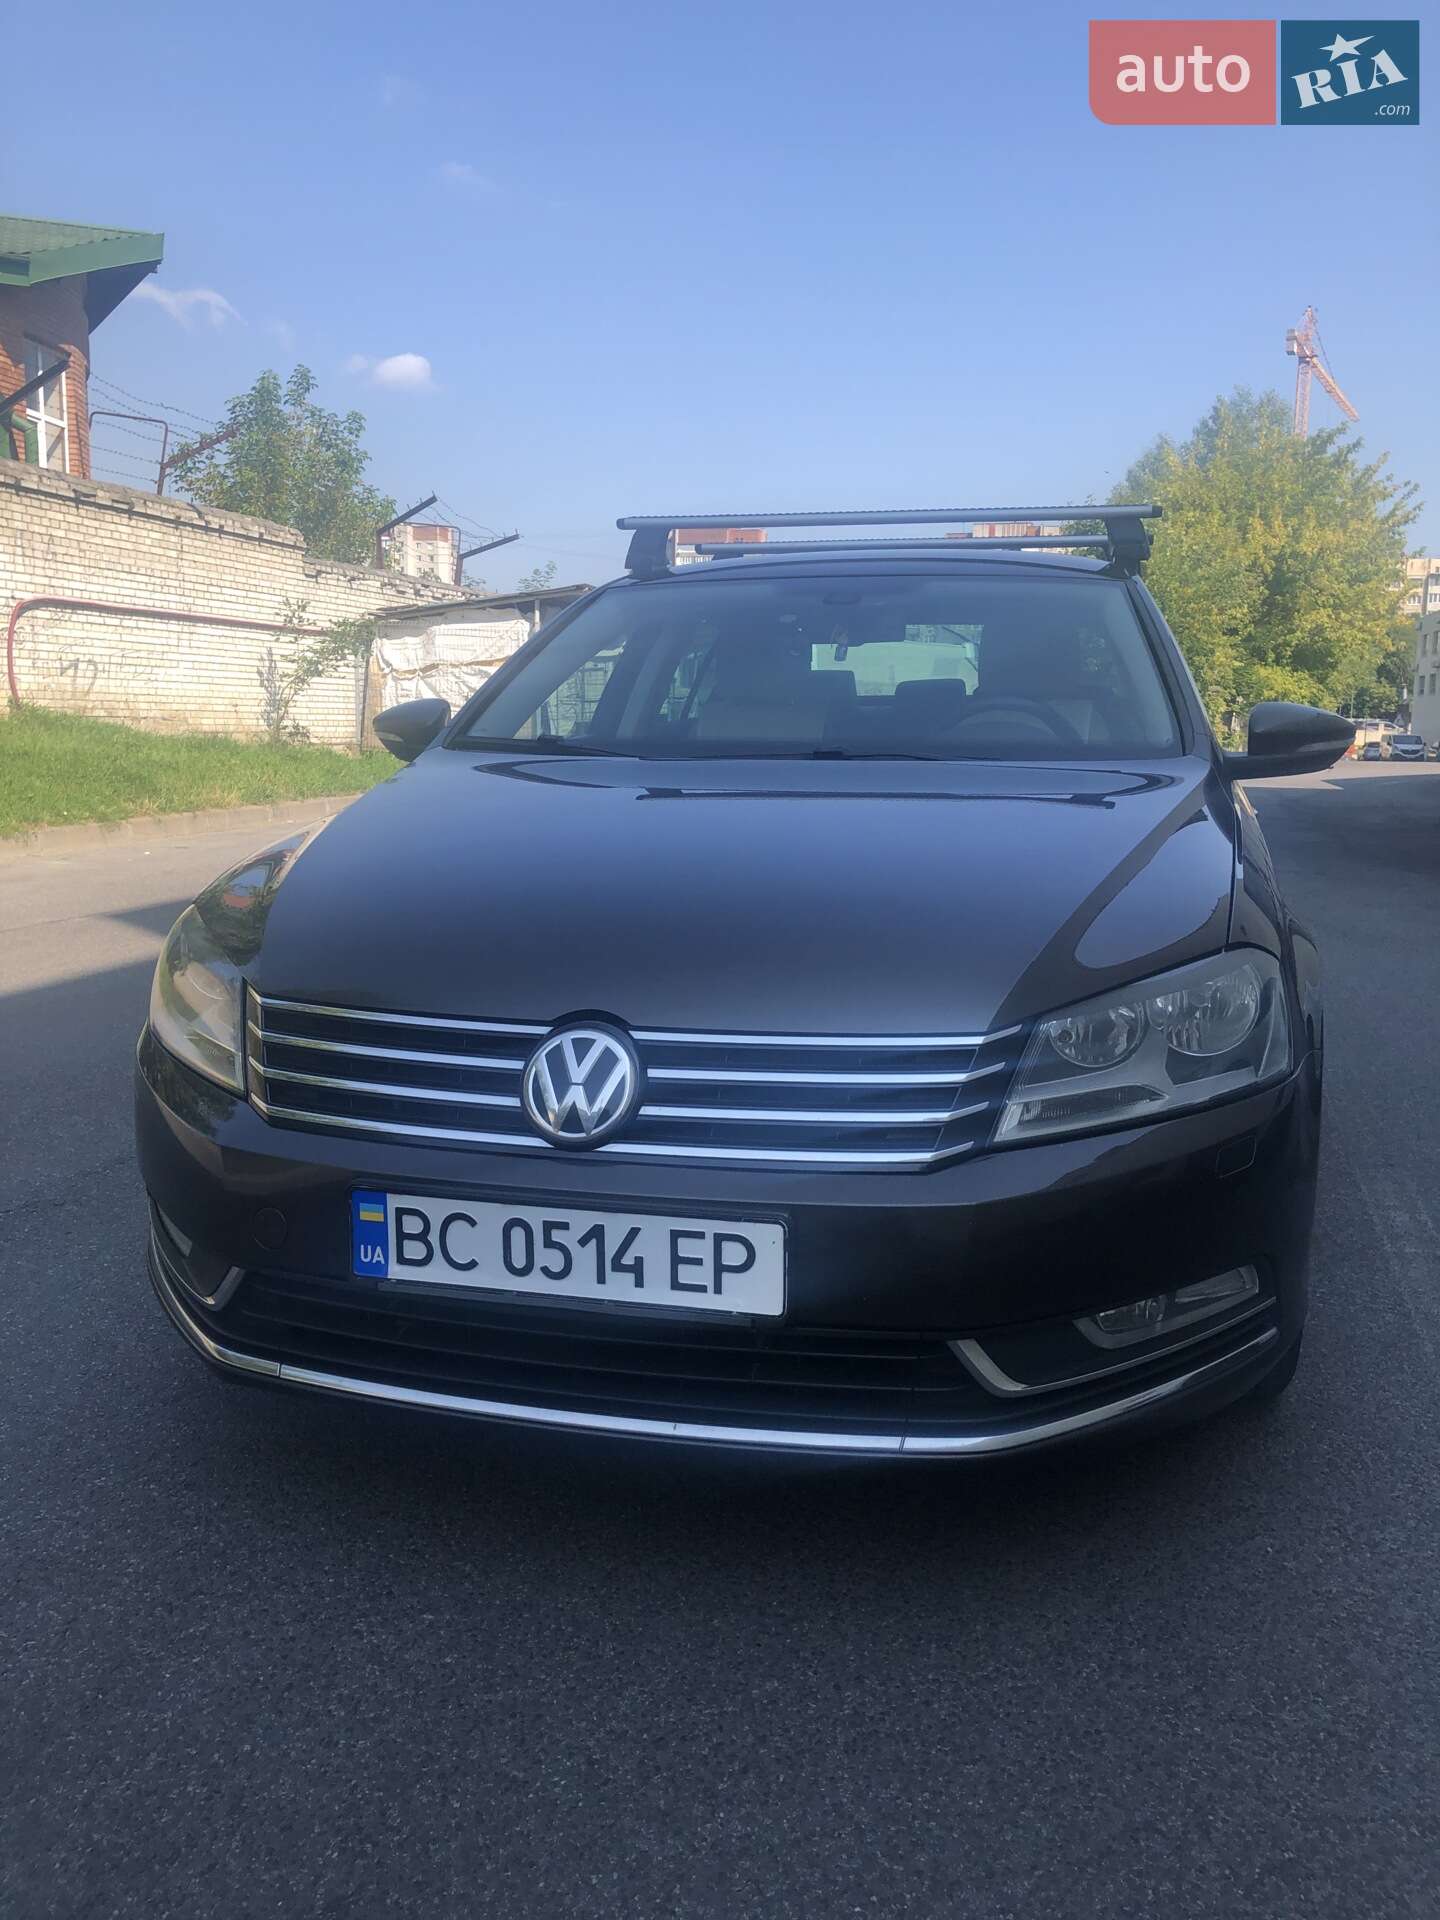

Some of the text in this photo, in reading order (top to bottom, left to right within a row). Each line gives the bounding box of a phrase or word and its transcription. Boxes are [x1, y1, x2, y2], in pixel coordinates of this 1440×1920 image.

[360, 1244, 385, 1265] UA
[394, 1206, 757, 1295] BC 0514 EP
